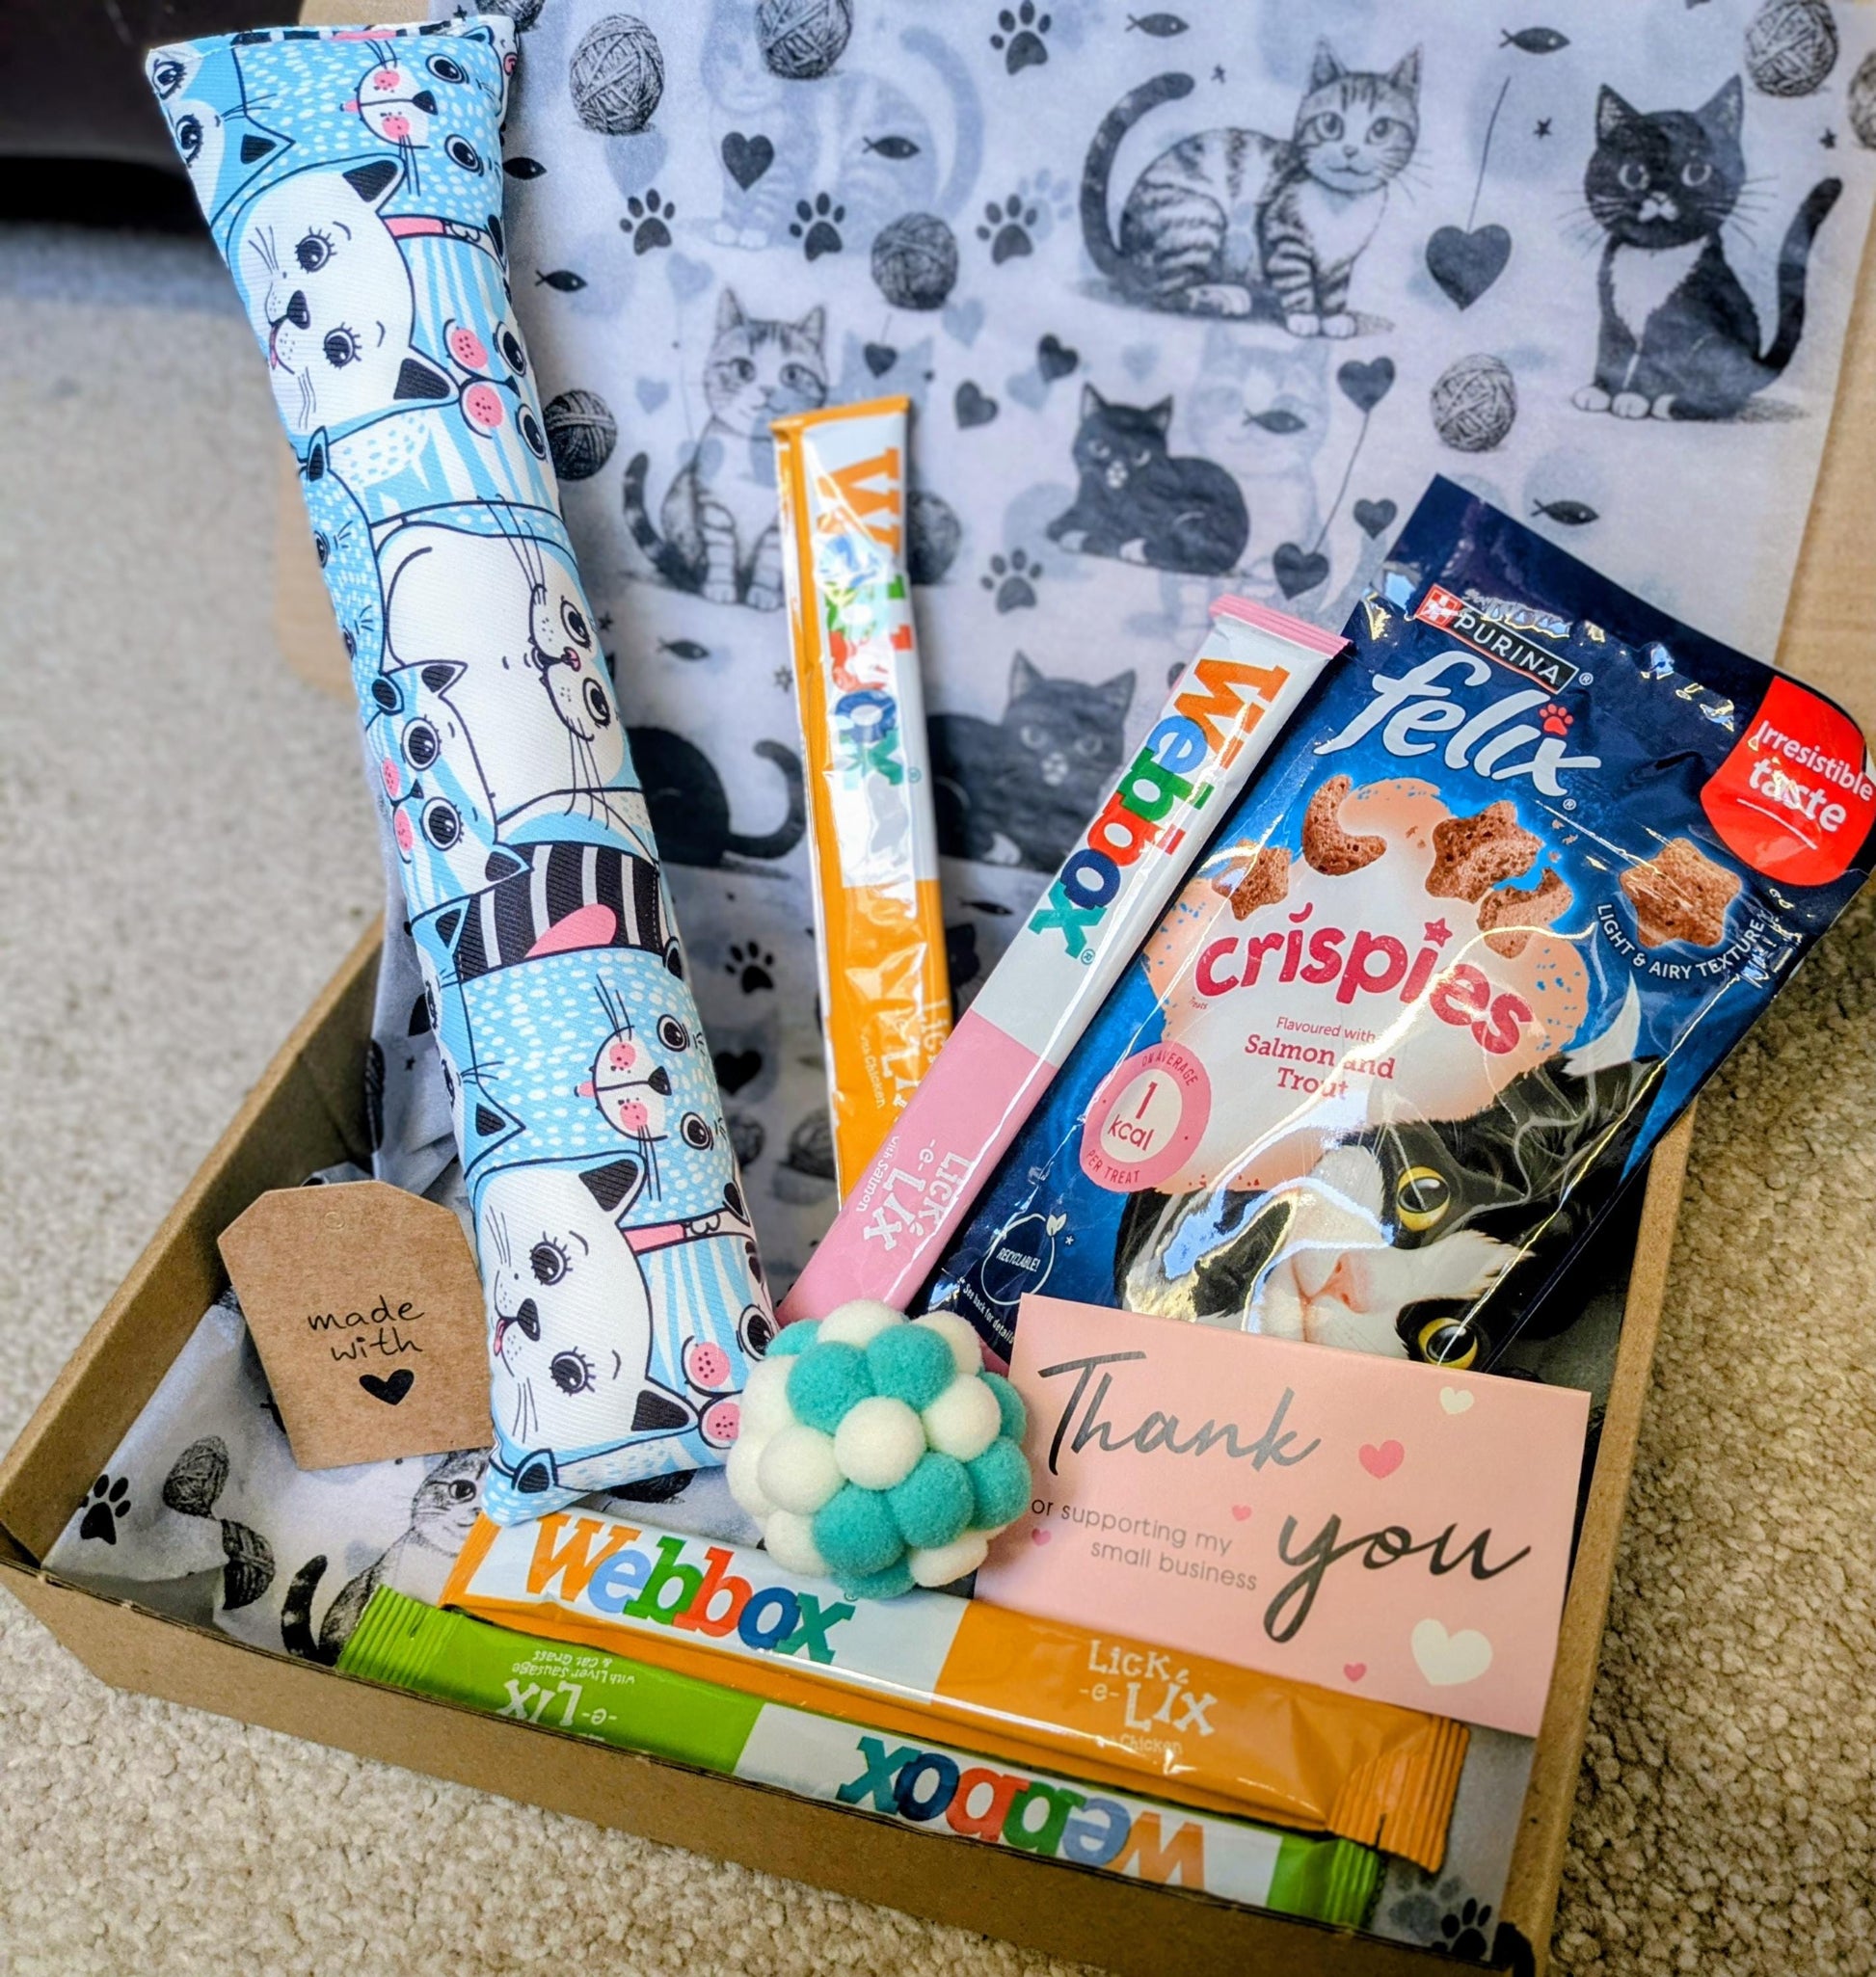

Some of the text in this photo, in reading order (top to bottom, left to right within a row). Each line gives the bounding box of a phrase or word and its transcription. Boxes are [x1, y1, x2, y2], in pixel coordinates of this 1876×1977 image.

[1453, 612, 1560, 684] PURINA
[1313, 651, 1601, 796] felix
[1750, 720, 1873, 801] Irresistible
[1028, 658, 1290, 959] Webbox
[1749, 759, 1846, 832] taste
[1597, 904, 1635, 955] LIGHT
[1633, 952, 1646, 967] &
[1648, 963, 1693, 979] AIRY
[1195, 902, 1533, 1054] crispies
[1276, 1016, 1377, 1043] Flavoured with
[1141, 1050, 1198, 1086] ON AVERAGE
[1245, 1034, 1395, 1080] Salmon and
[1135, 1082, 1158, 1119] 1
[1277, 1067, 1349, 1100] Trout
[1108, 1114, 1155, 1151] kcal
[856, 1160, 889, 1212] Salmon
[1086, 1149, 1140, 1184] PER TREAT
[996, 1247, 1041, 1272] RECYCLABLE!
[308, 1295, 425, 1330] made
[331, 1327, 423, 1361] with
[1037, 1350, 1322, 1476] Thank
[1032, 1499, 1233, 1556] or supporting my
[526, 1511, 856, 1665] Webbox
[1090, 1541, 1257, 1590] small business
[1262, 1513, 1532, 1643] you
[512, 1661, 635, 1685] with Liver Sausage
[532, 1649, 613, 1668] & Cat Grass
[1120, 1732, 1183, 1756] Chicken
[835, 1736, 1205, 1890] Webbox
